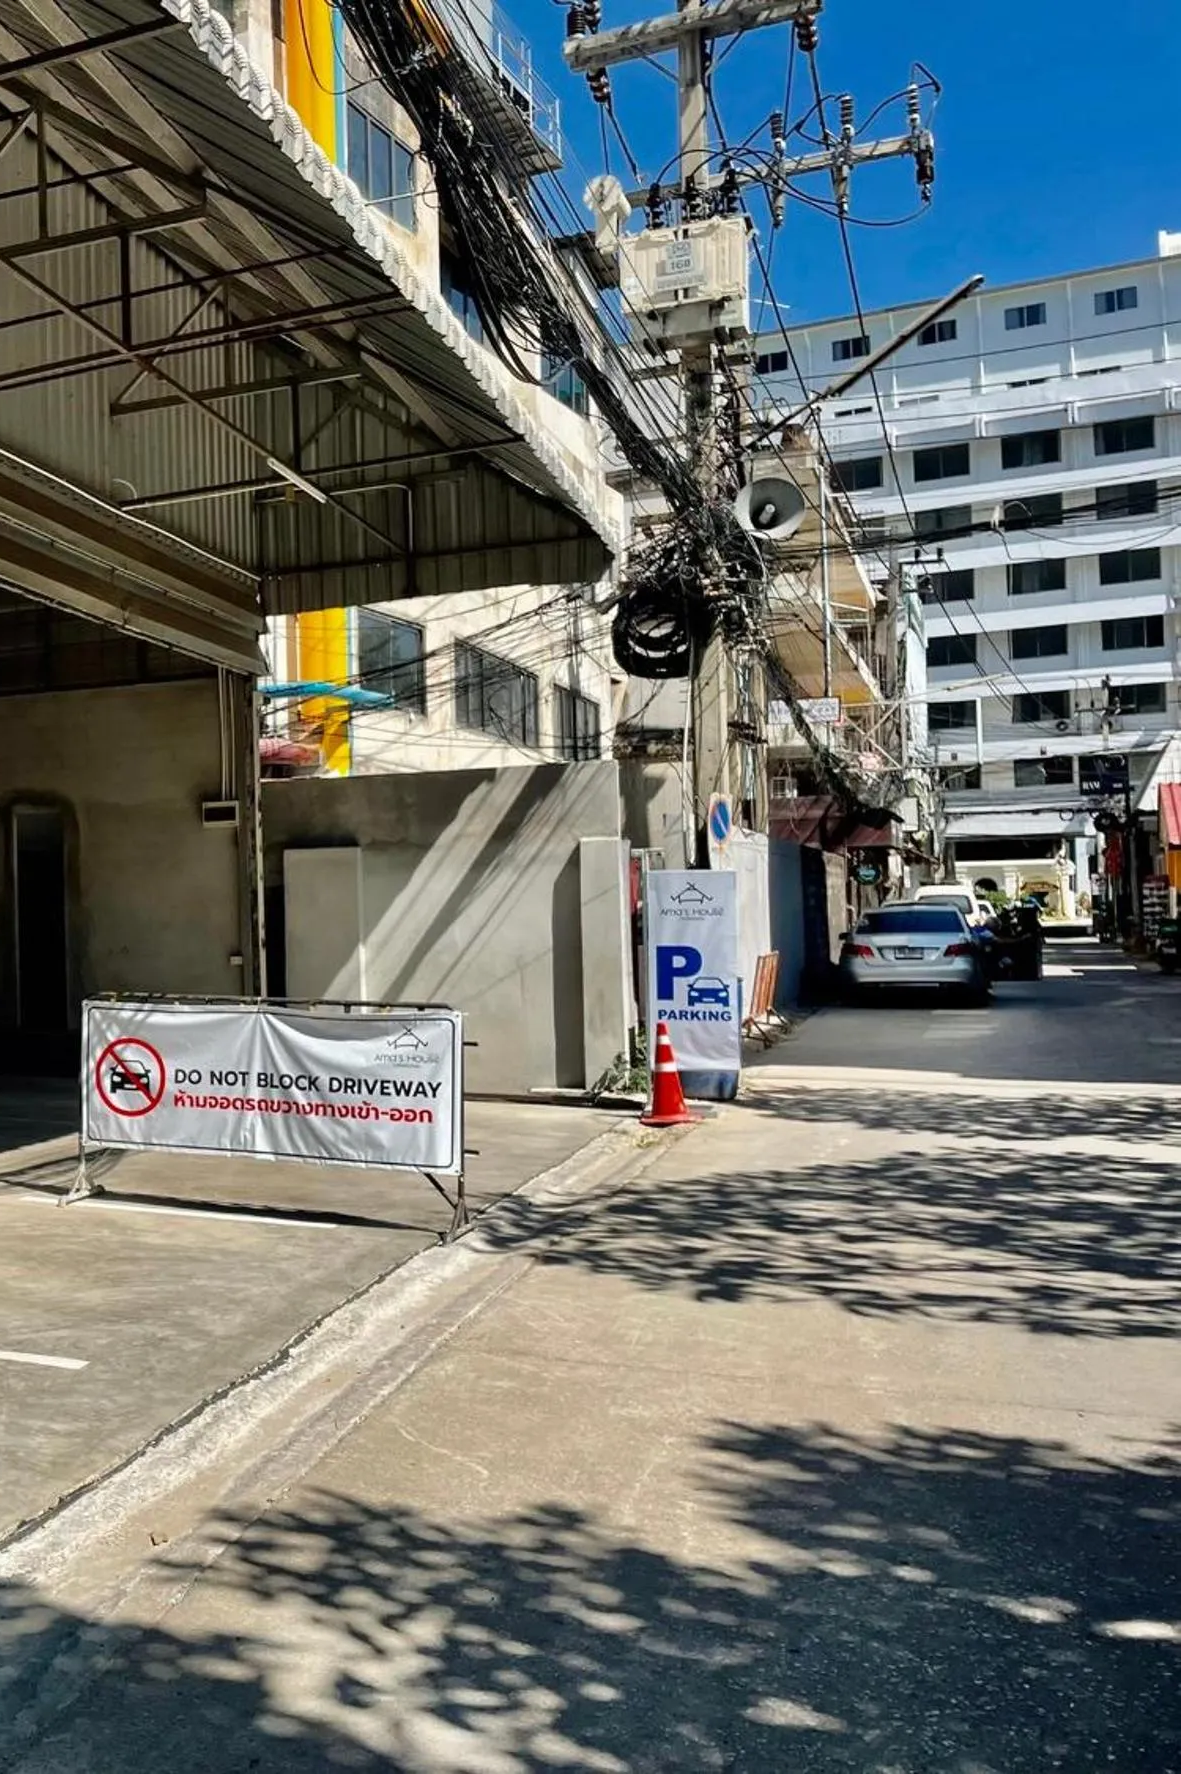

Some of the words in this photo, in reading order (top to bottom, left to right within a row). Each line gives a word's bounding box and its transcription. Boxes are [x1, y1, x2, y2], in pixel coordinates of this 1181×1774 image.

[655, 945, 703, 1001] P
[657, 1008, 732, 1022] PARKING
[174, 1068, 202, 1085] DO
[209, 1070, 249, 1087] NOT
[257, 1072, 321, 1092] BLOCK
[328, 1076, 442, 1099] DRIVEWAY
